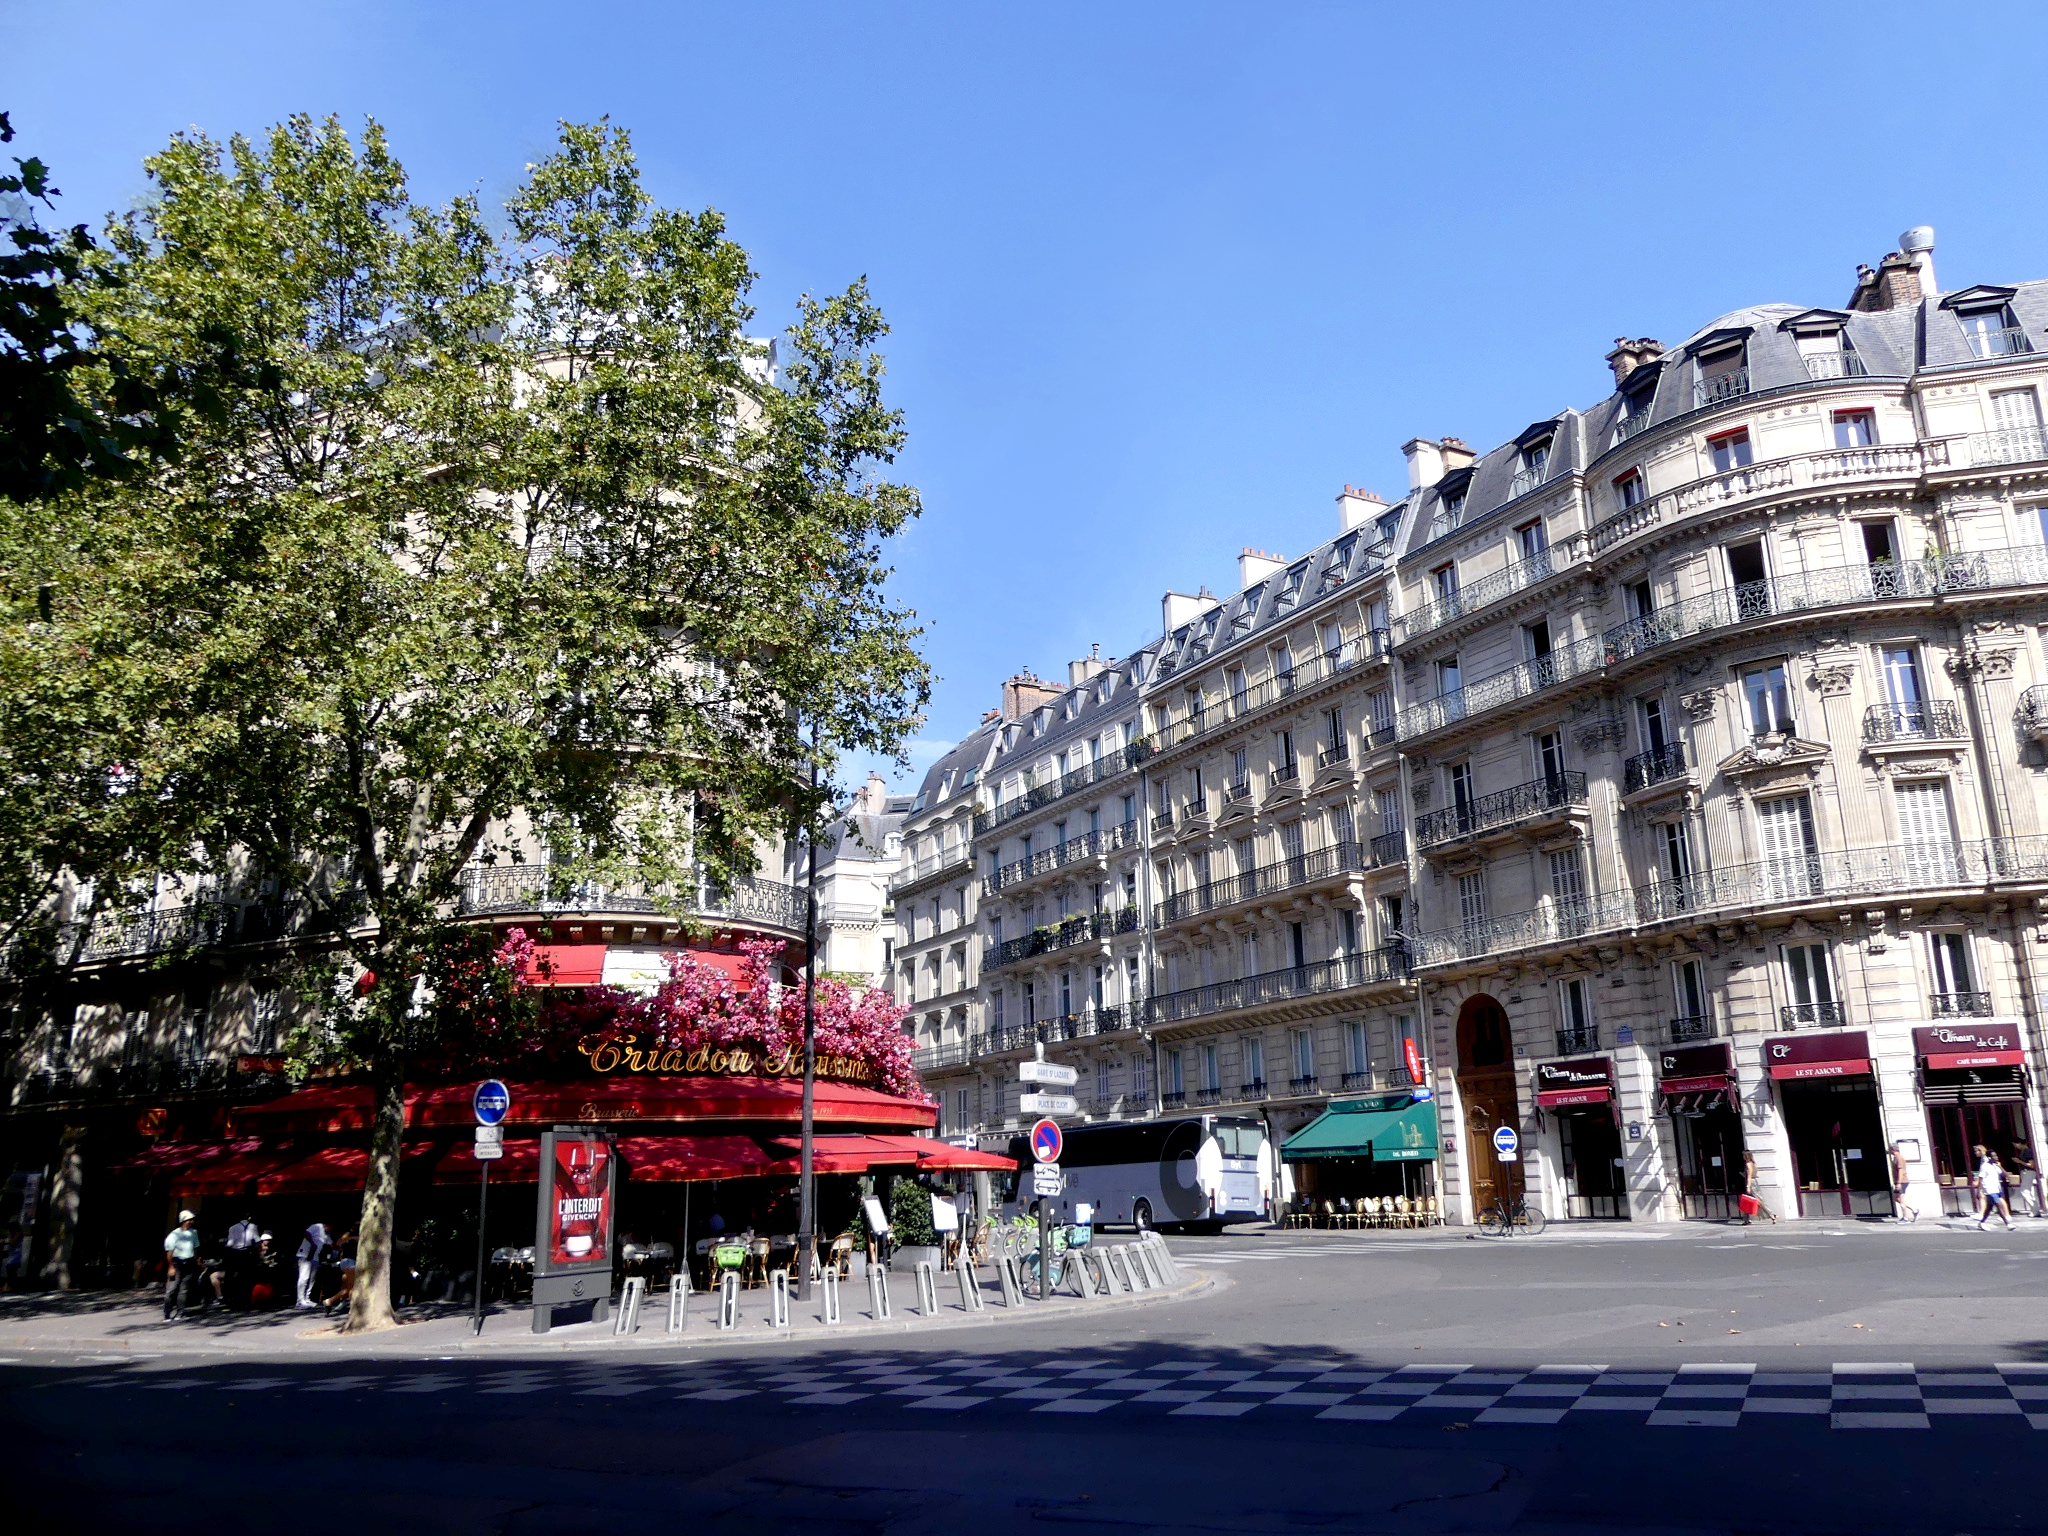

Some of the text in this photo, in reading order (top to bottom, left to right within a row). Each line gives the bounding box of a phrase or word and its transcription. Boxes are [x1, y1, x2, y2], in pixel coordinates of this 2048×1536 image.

[1054, 1070, 1069, 1080] LAZARE
[1814, 1067, 1843, 1075] AMOUR
[578, 1102, 640, 1118] Brasserie
[558, 1198, 603, 1214] L'INTERDIT
[562, 1213, 598, 1222] GIVENCHY
